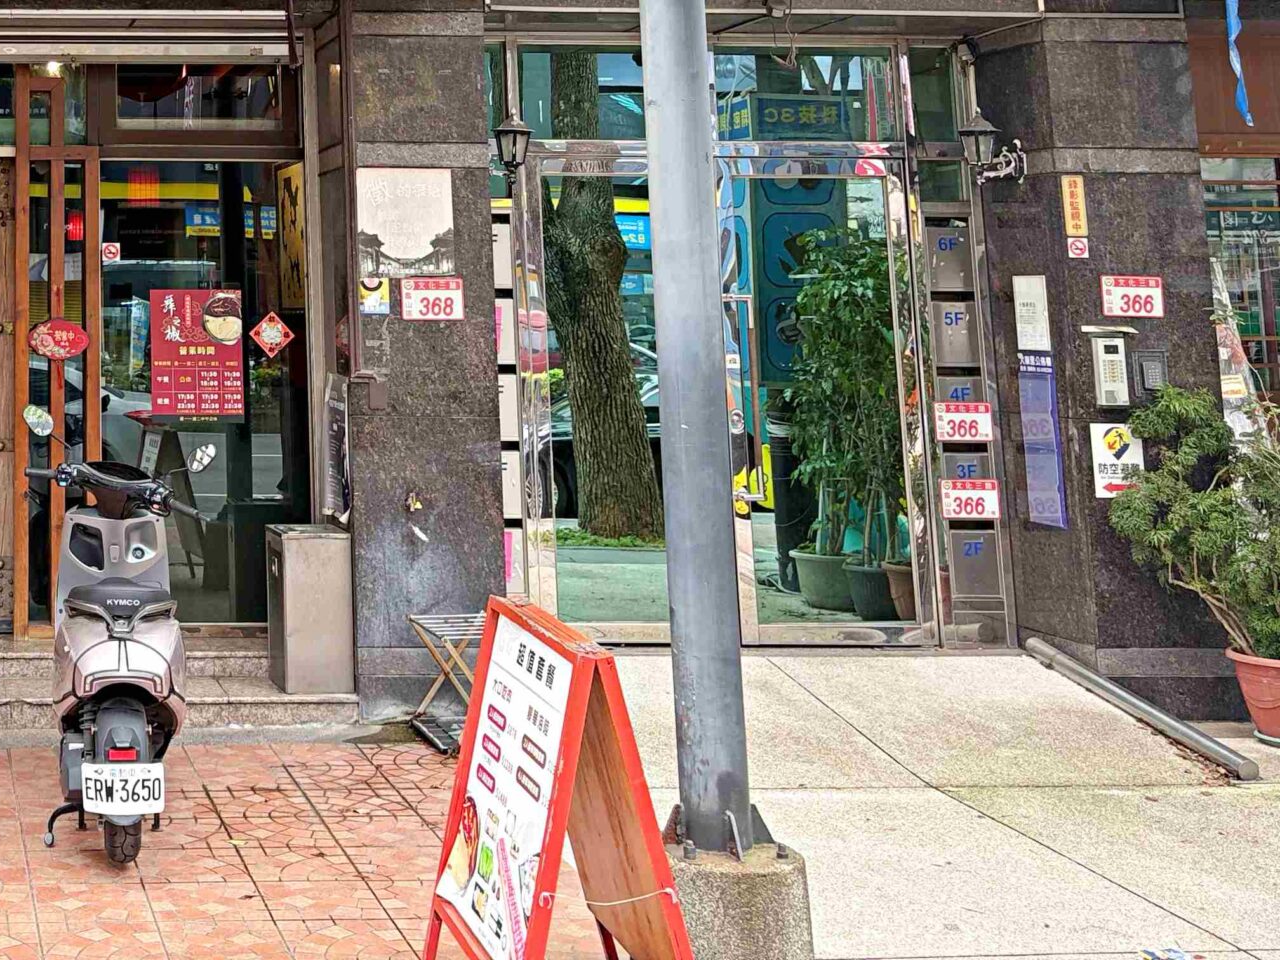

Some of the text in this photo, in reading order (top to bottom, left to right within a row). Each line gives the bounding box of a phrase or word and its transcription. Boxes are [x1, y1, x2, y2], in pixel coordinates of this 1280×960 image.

[1068, 179, 1081, 232] 錄影監視中
[938, 237, 957, 252] 6F
[419, 297, 454, 316] 368
[1120, 294, 1154, 313] 366
[943, 311, 964, 326] 5F
[950, 387, 970, 401] 4F
[946, 419, 979, 437] 366
[957, 464, 977, 478] 3F
[953, 497, 985, 515] 366
[963, 542, 984, 557] 2F
[106, 598, 140, 607] KYMCO
[85, 777, 161, 803] ERW-3650
